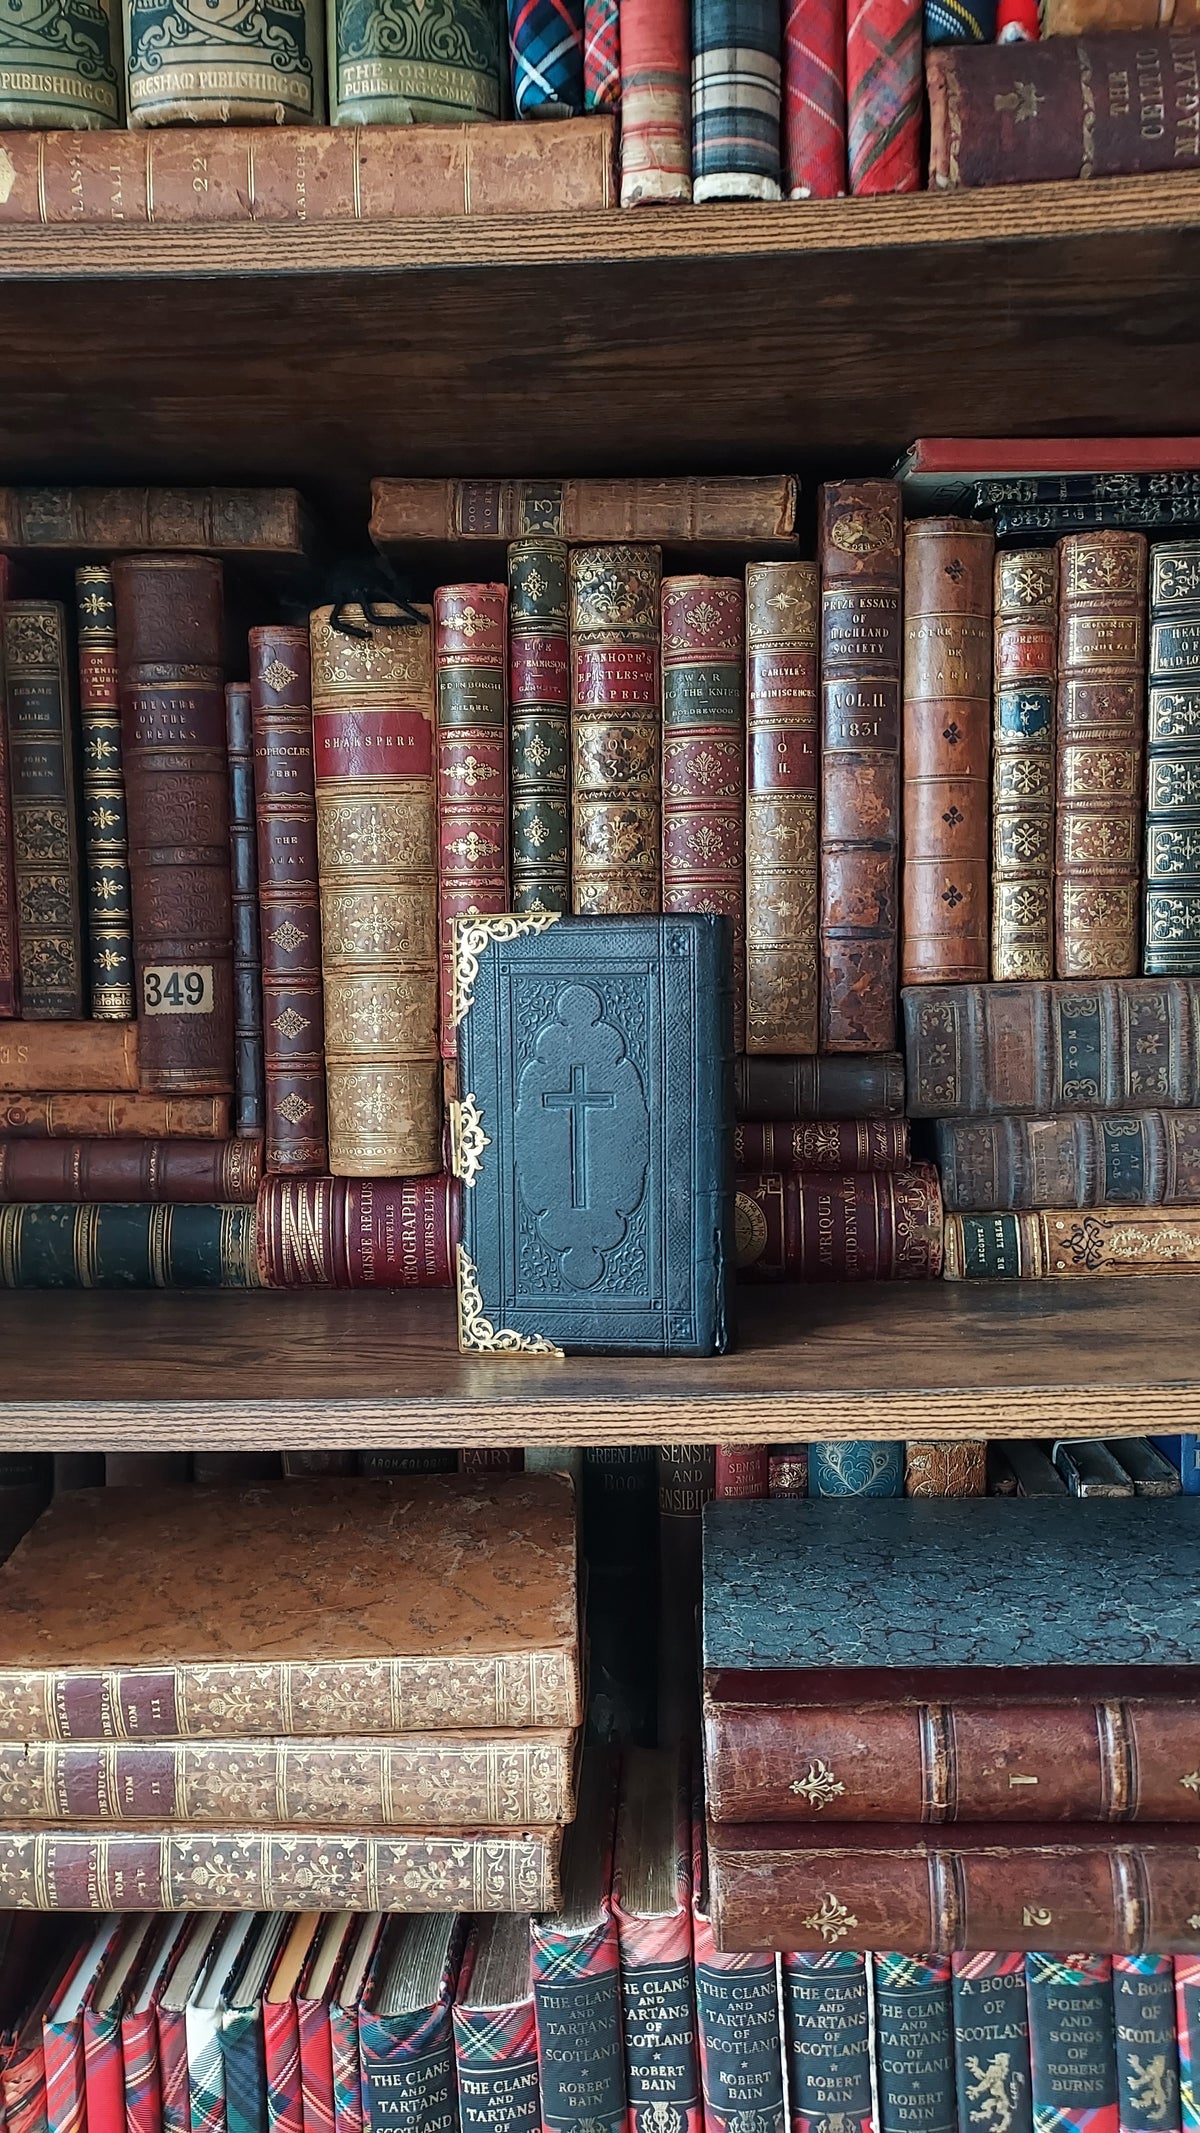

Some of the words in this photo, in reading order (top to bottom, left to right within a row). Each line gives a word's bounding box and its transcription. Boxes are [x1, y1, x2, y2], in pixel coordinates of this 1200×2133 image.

[343, 63, 383, 82] THE
[1, 72, 93, 100] PUBLISHING
[199, 71, 289, 94] PUBLISHING
[859, 598, 897, 610] ESSAYS
[852, 615, 867, 624] OF
[830, 628, 889, 640] HIGHLAND
[833, 644, 884, 654] SOCIETY
[1181, 641, 1199, 651] OF
[90, 658, 103, 666] ON
[683, 672, 721, 682] WAR
[578, 690, 649, 701] GOSPELS
[683, 689, 703, 697] THE
[132, 700, 197, 711] THEATRE
[18, 712, 51, 721] LILIES
[139, 715, 155, 725] OF
[161, 714, 187, 724] THE
[324, 736, 416, 749] SHAKSPERE
[255, 747, 310, 757] SOPHOCLES
[275, 836, 298, 845] THE
[145, 971, 204, 1007] 349
[360, 1182, 374, 1231] RECLUS
[385, 1203, 396, 1263] NOUVELLE
[424, 1186, 436, 1276] UNIVERSELLE
[818, 1195, 835, 1267] AFRIQUE
[994, 1218, 1005, 1249] LISLE
[672, 1470, 703, 1482] AND
[151, 1699, 161, 1719] III
[127, 1705, 139, 1729] TOM
[125, 1775, 134, 1803] TOM
[151, 1781, 160, 1795] II
[114, 1870, 124, 1898] TOM
[1022, 1904, 1052, 1927] 2
[643, 1976, 690, 1995] CLANS
[700, 1980, 729, 1999] THE
[732, 1980, 777, 2000] CLANS
[959, 1980, 975, 1996] A
[979, 1973, 1025, 1994] BOOK
[1120, 1980, 1134, 1996] A
[541, 1994, 570, 2009] THE
[574, 1986, 618, 2007] CLANS
[789, 1985, 822, 2000] THE
[638, 1997, 665, 2006] AND
[727, 2002, 754, 2012] AND
[818, 2003, 846, 2013] AND
[983, 2000, 1006, 2014] OF
[1047, 1999, 1104, 2011] POEMS
[568, 2008, 595, 2019] AND
[624, 2004, 690, 2021] ARTANS
[906, 2001, 944, 2019] CLAN
[1141, 2005, 1162, 2020] OF
[706, 2009, 776, 2027] TARTANS
[795, 2011, 867, 2029] TARTANS
[1060, 2016, 1093, 2028] AND
[546, 2015, 617, 2036] TARTANS
[645, 2022, 662, 2032] OF
[899, 2020, 928, 2031] AND
[624, 2031, 693, 2048] COTLAND
[733, 2030, 750, 2039] OF
[824, 2031, 841, 2042] OF
[879, 2028, 949, 2047] TARTANS
[1049, 2031, 1104, 2042] SONGS
[706, 2036, 779, 2055] SCOTLAND
[793, 2039, 870, 2058] SCOTLAND
[545, 2042, 620, 2063] SCOTLAND
[906, 2048, 923, 2059] OF
[1067, 2048, 1089, 2059] OF
[371, 2074, 402, 2088] THE
[405, 2060, 451, 2084] CLANS
[630, 2065, 686, 2077] ROBERT
[1047, 2063, 1106, 2075] ROBERT
[461, 2078, 490, 2095] THE
[492, 2072, 539, 2094] CLANS
[640, 2079, 677, 2091] BAIN
[719, 2071, 772, 2086] ROBERT
[806, 2074, 862, 2089] ROBERT
[1051, 2079, 1104, 2091] BURNS
[400, 2085, 427, 2098] AND
[559, 2078, 612, 2093] ROBERT
[728, 2087, 764, 2100] BAIN
[817, 2090, 853, 2102] BAIN
[888, 2091, 944, 2106] ROBERT
[378, 2087, 448, 2114] TARTANS
[487, 2094, 514, 2107] AND
[568, 2094, 604, 2107] BAIN
[466, 2101, 537, 2123] TARTANS
[898, 2106, 935, 2119] BAIN
[406, 2113, 423, 2125] OF
[494, 2123, 511, 2133] OF
